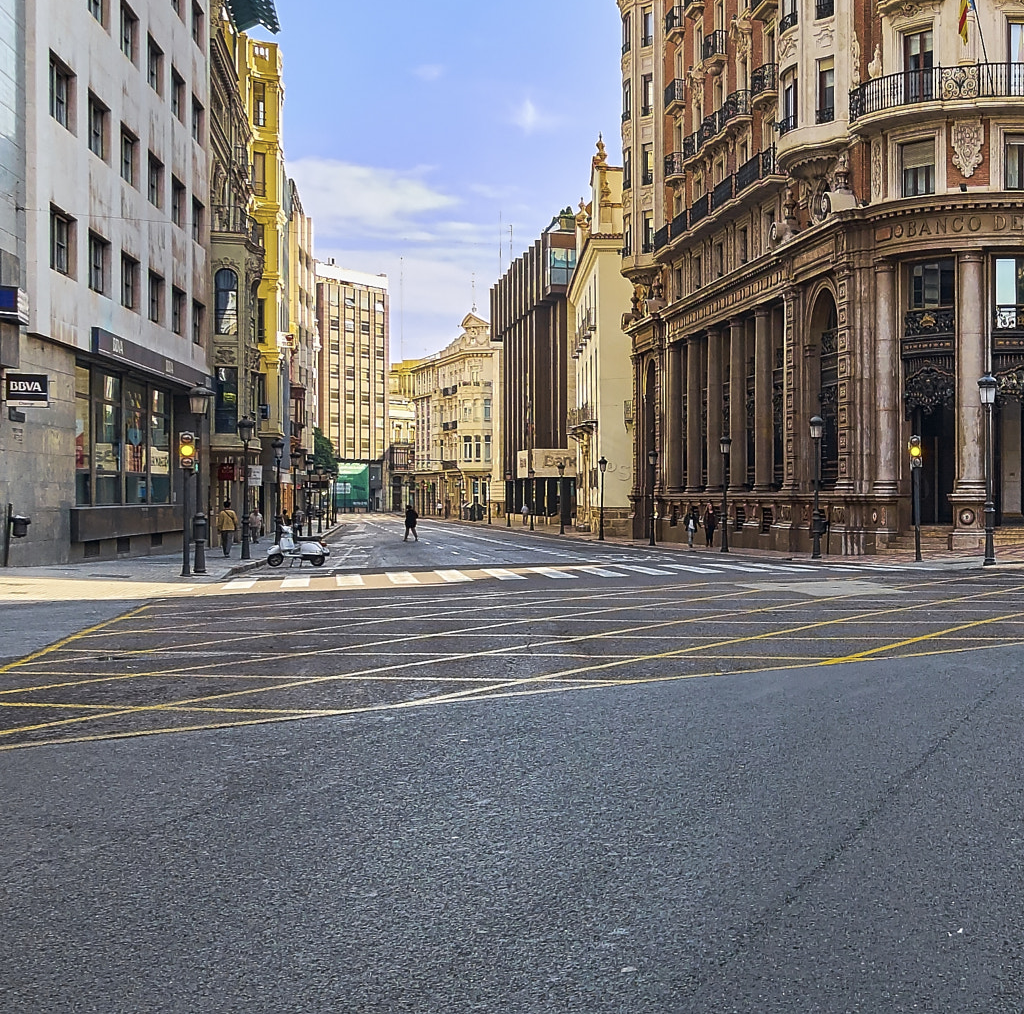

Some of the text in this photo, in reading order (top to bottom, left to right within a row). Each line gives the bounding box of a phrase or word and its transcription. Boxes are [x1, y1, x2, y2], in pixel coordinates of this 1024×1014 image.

[907, 215, 982, 238] BANCO
[993, 213, 1023, 231] DE
[9, 381, 43, 392] BBVA
